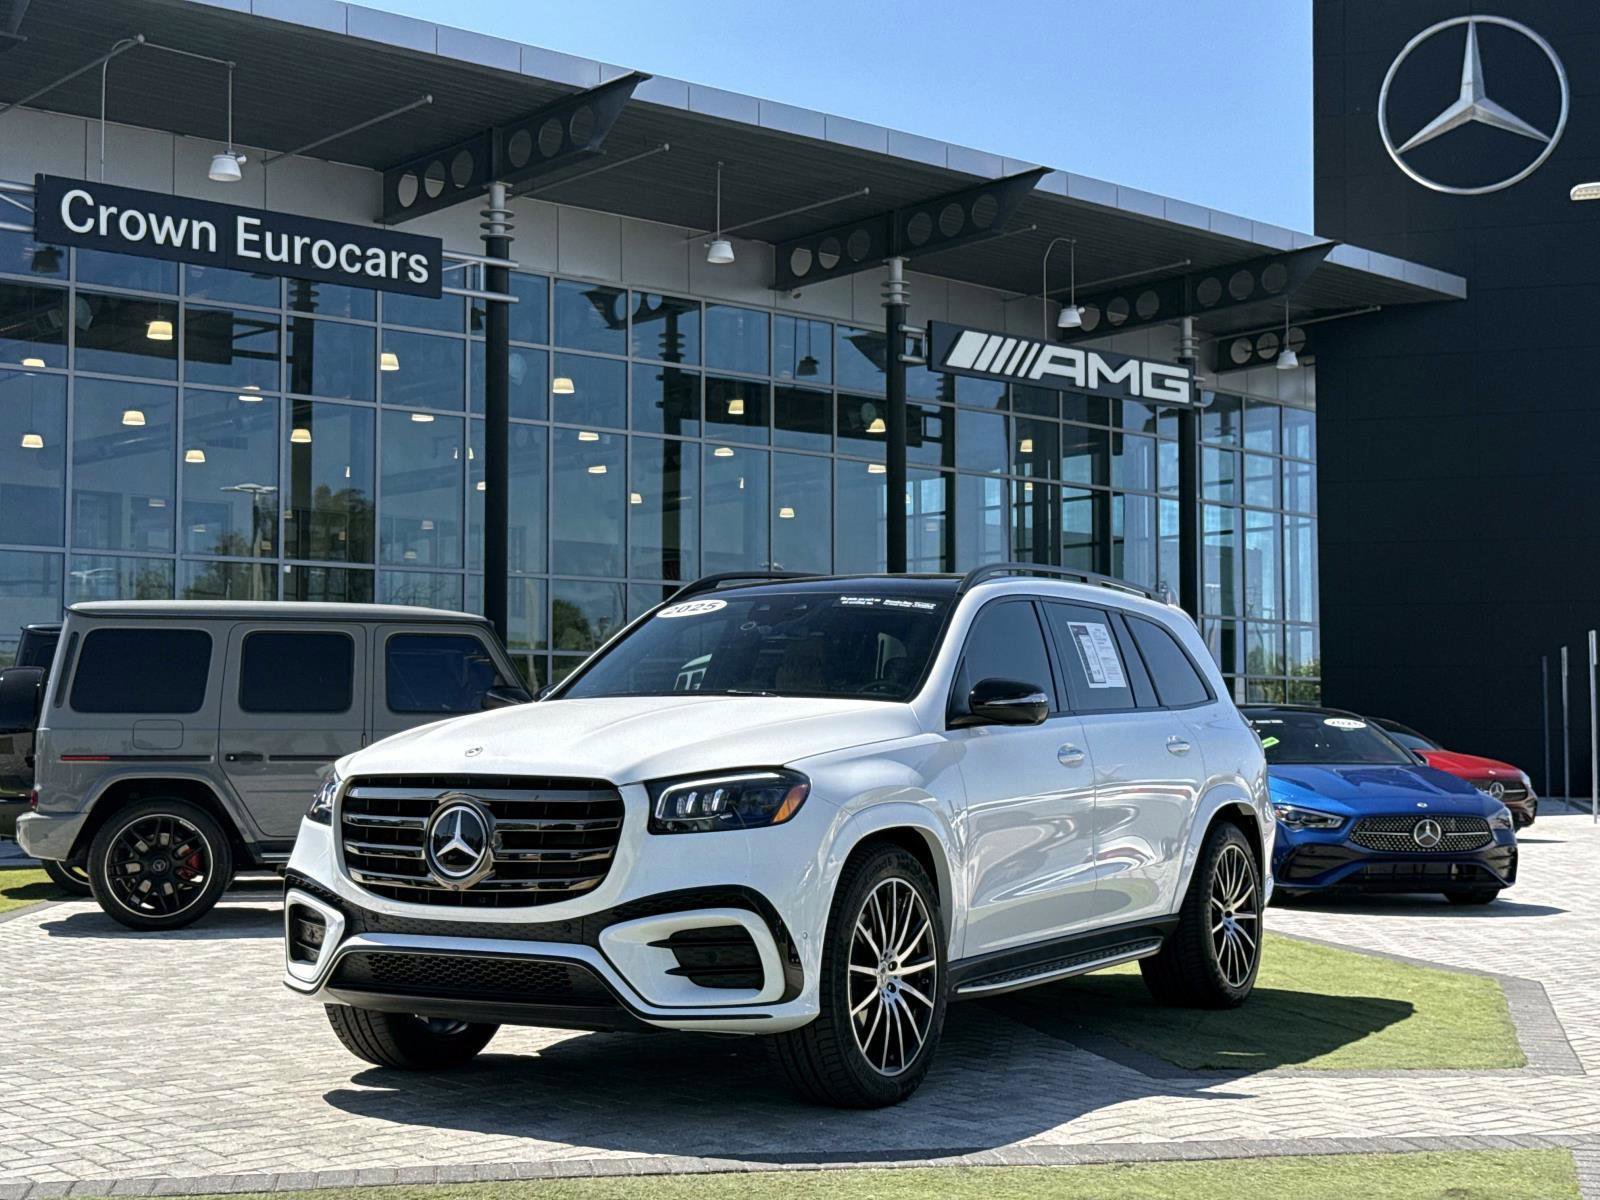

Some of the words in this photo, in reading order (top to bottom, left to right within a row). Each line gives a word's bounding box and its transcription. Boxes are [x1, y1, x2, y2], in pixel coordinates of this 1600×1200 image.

[60, 189, 217, 252] Crown
[236, 215, 429, 284] Eurocars
[1028, 343, 1190, 403] AMG
[662, 602, 721, 615] 2025
